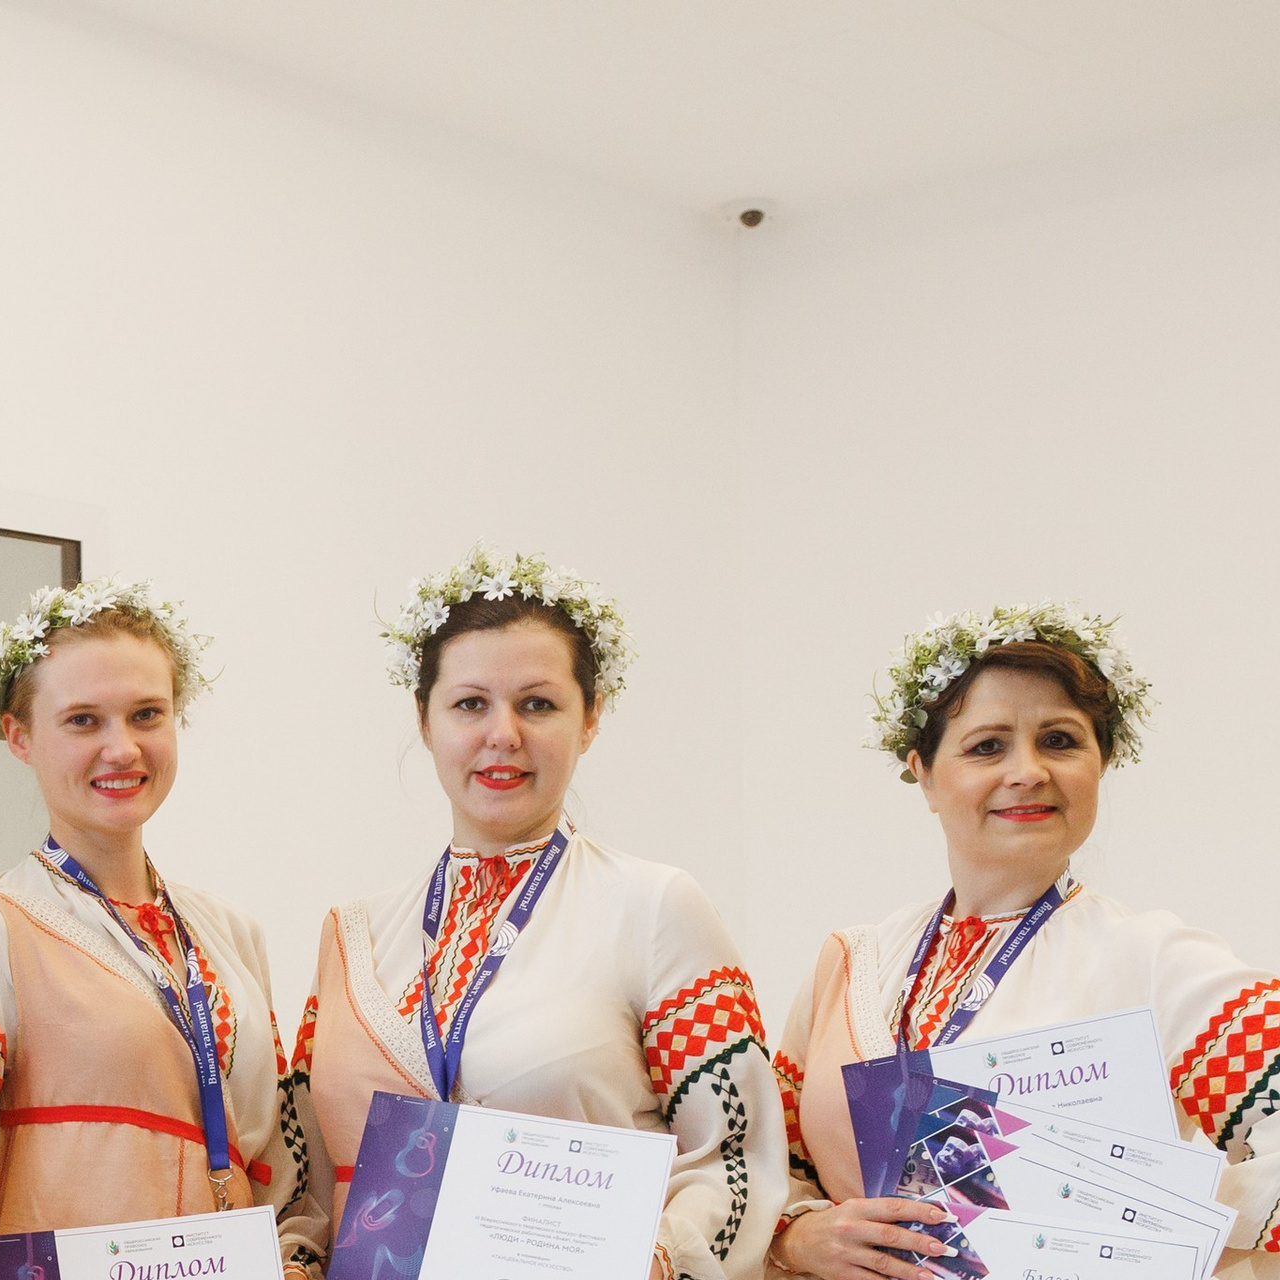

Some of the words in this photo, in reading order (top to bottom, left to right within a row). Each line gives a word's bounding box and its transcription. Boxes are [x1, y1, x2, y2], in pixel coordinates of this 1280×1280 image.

[539, 845, 561, 871] Виват,
[519, 871, 544, 912] таланты!
[1025, 901, 1052, 926] Виват,
[998, 926, 1030, 965] таланты!
[469, 970, 492, 997] Виват,
[193, 1000, 212, 1048] таланты!
[425, 1016, 436, 1050] Виват,
[452, 998, 473, 1043] таланты!
[938, 1024, 960, 1046] Вива
[207, 1050, 217, 1085] Виват,
[988, 1062, 1109, 1095] Диплом
[1057, 1096, 1103, 1108] Николаевна
[497, 1150, 614, 1189] Диплом
[490, 1185, 517, 1196] Уфаева
[518, 1190, 556, 1203] Екатерина
[558, 1197, 601, 1209] Алексеевна
[522, 1216, 562, 1228] ФИНАЛИСТ
[489, 1232, 519, 1244] «ЛЮДИ
[526, 1238, 560, 1251] РОДИНА
[562, 1245, 585, 1254] МОЯ»
